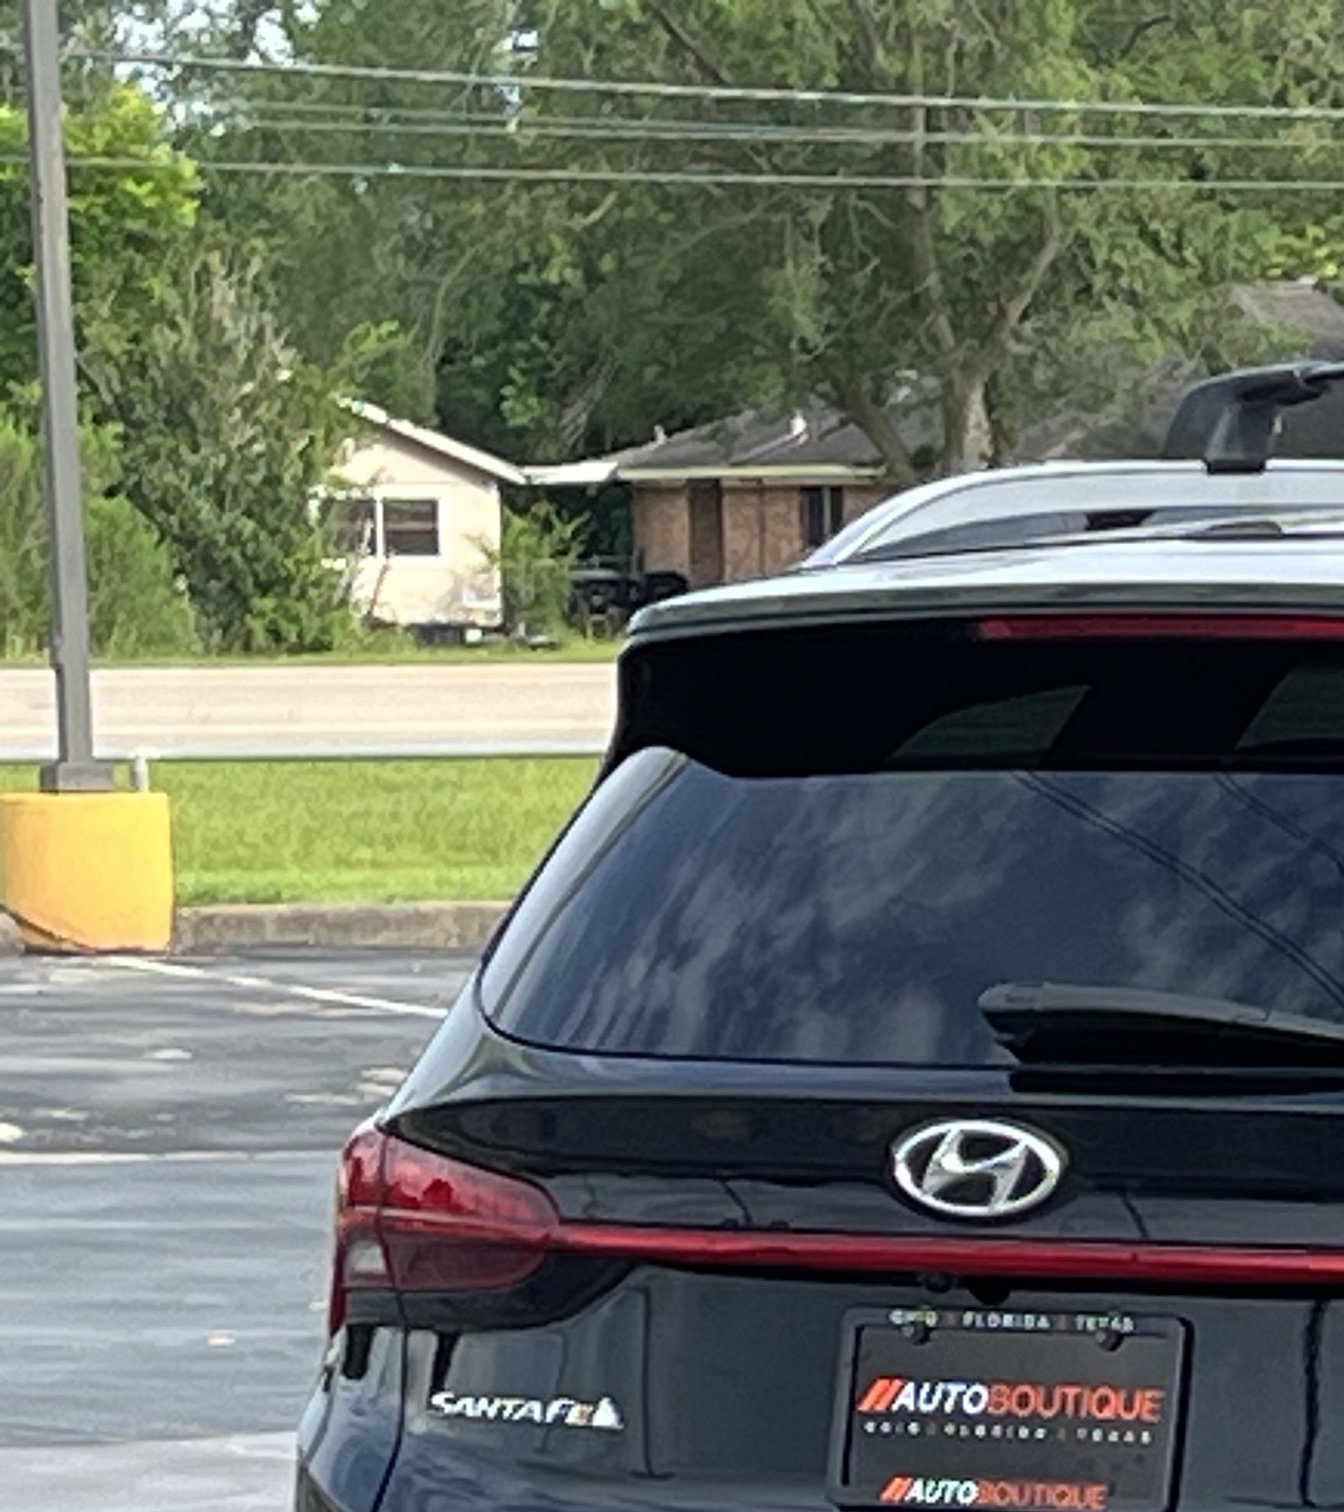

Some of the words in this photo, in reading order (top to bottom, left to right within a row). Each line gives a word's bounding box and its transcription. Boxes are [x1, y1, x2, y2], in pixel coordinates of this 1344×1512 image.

[962, 1311, 1051, 1330] FLORIDA
[892, 1380, 1165, 1422] AUTOBOUTIQUE
[903, 1477, 1110, 1510] AUTOBOUTIQUE
